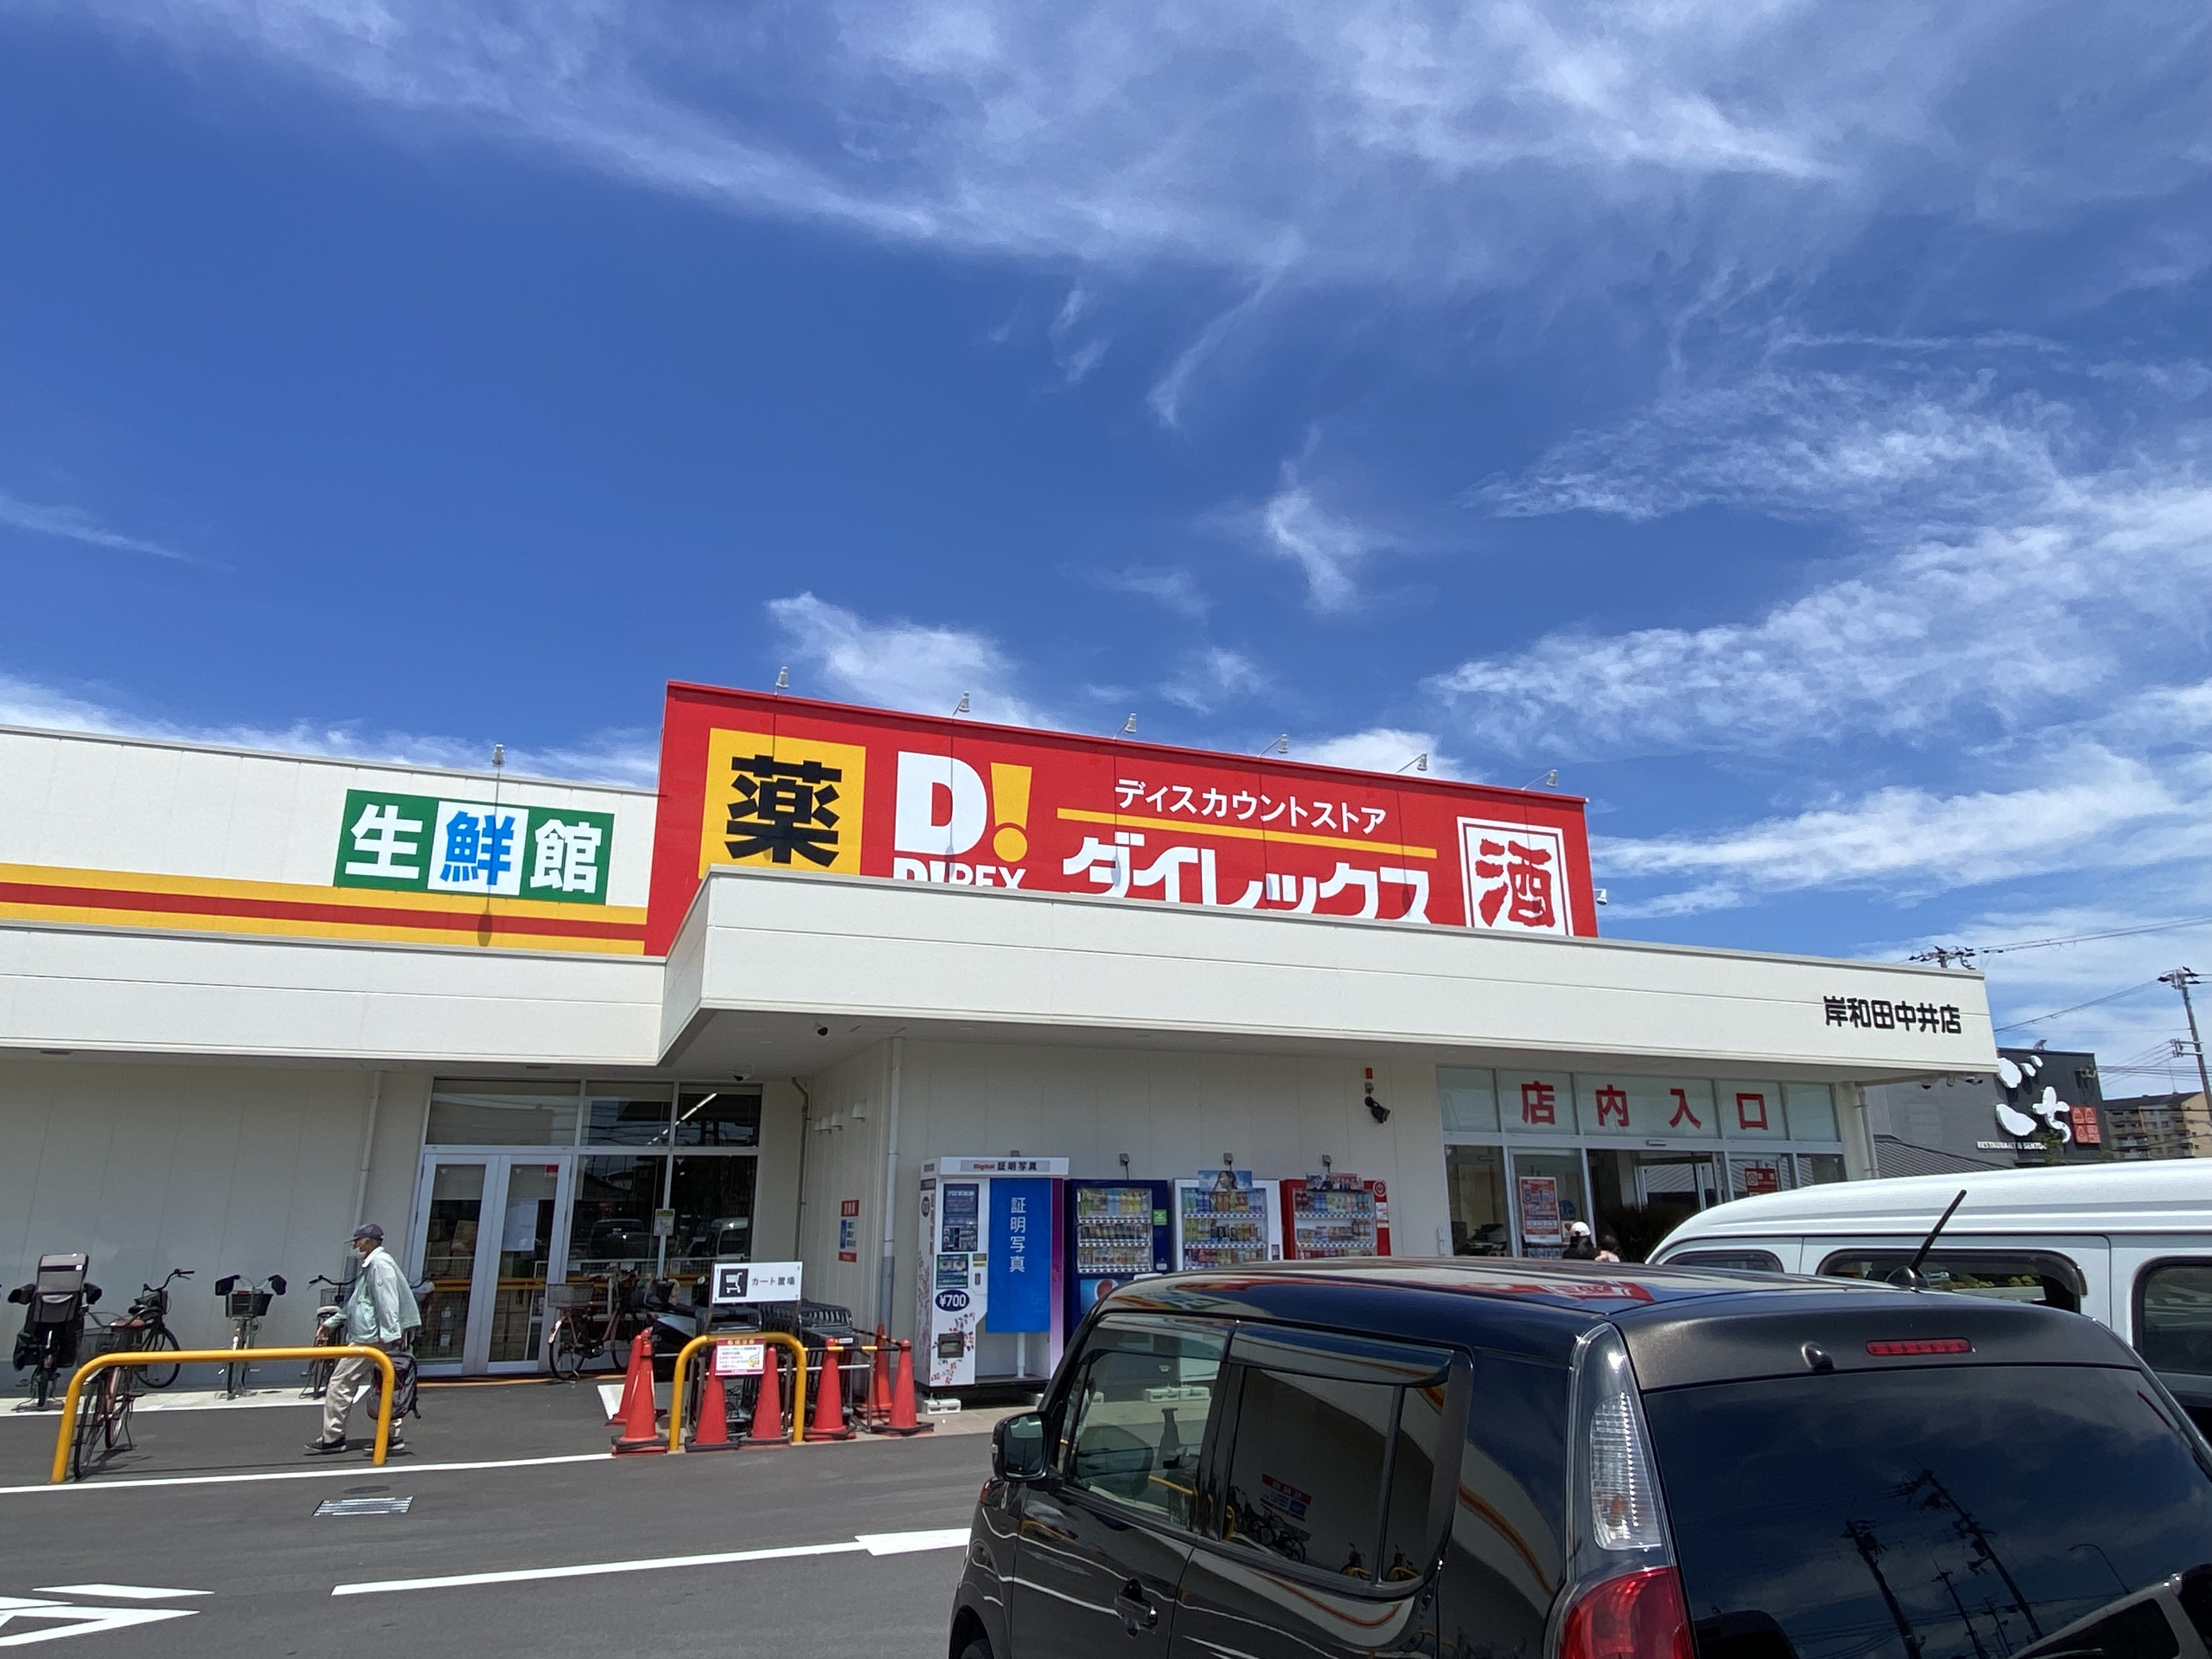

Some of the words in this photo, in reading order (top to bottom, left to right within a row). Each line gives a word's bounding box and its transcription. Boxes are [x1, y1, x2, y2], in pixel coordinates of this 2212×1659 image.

[725, 754, 843, 867] 薬
[1115, 778, 1387, 834] ディスカウントストア
[345, 804, 602, 894] 生鮮館
[1063, 832, 1430, 924] ダイレックス
[1475, 837, 1556, 928] 酒
[1824, 995, 1961, 1034] 岸和田中井店
[1521, 1081, 1768, 1130] 店内入口
[997, 1161, 1037, 1171] 証明写真
[1009, 1197, 1026, 1273] 証明写真
[752, 1277, 795, 1286] カート置場
[939, 1294, 966, 1307] ¥700
